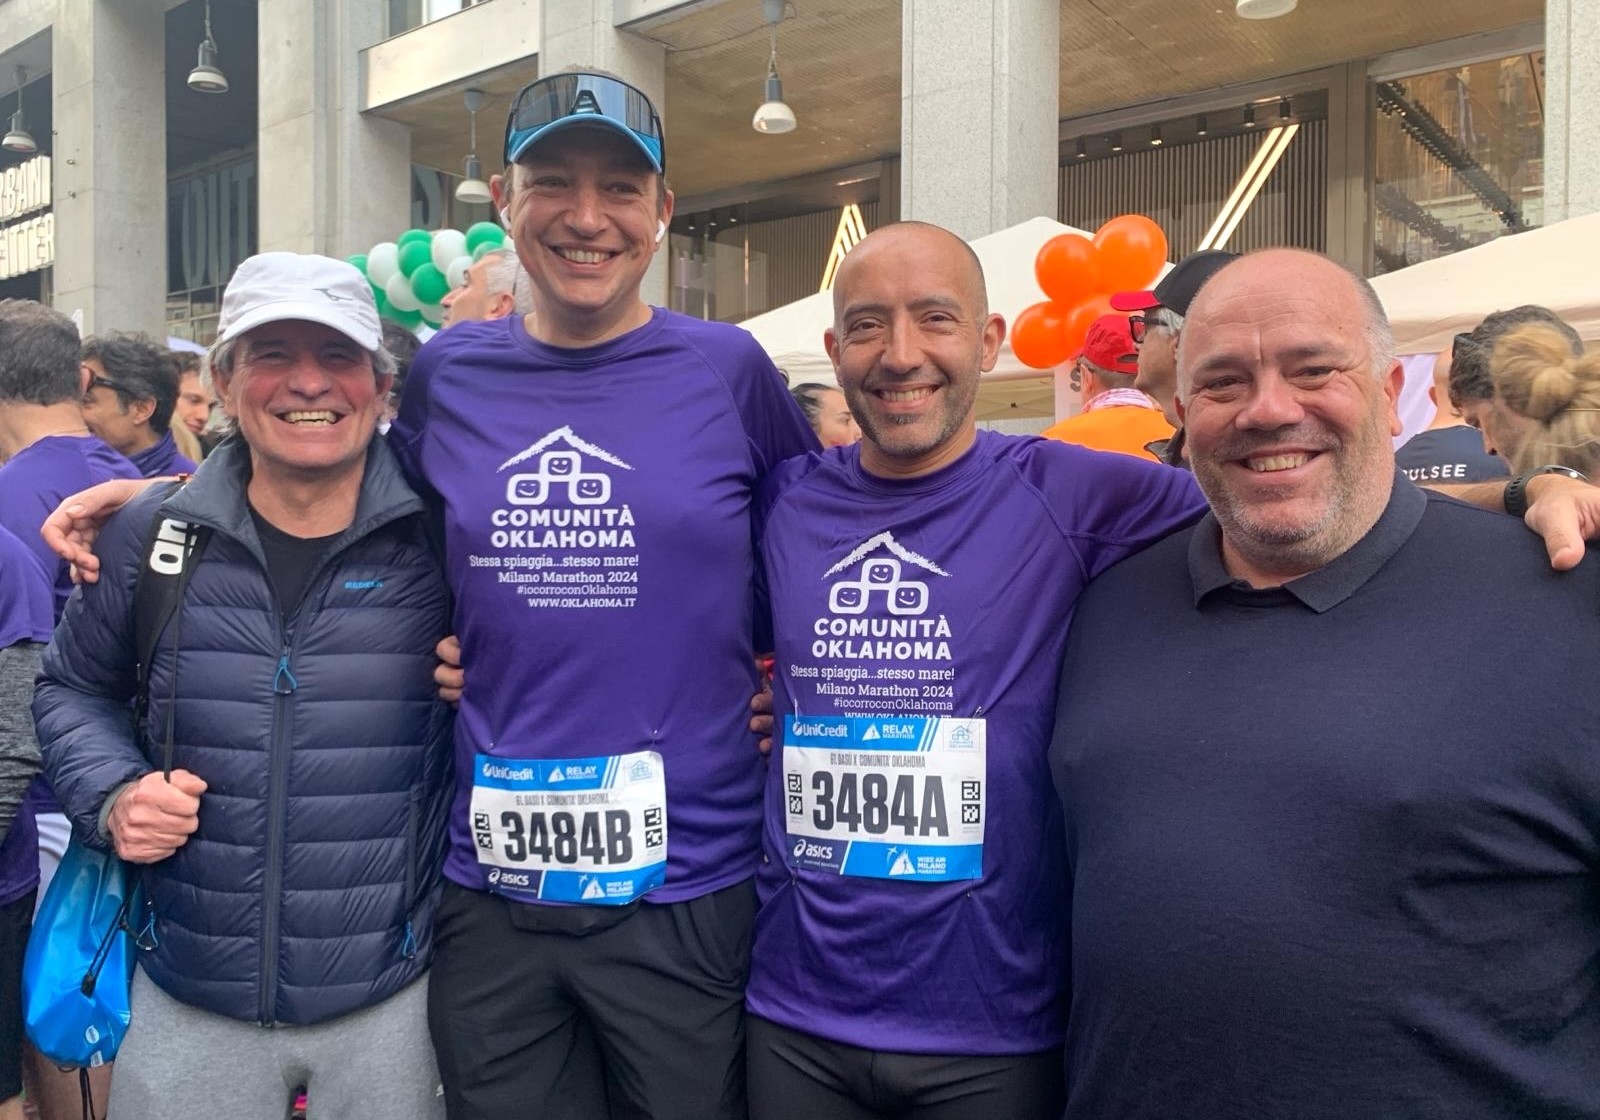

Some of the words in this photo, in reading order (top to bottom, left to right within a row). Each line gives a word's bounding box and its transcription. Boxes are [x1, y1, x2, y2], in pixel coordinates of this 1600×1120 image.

[1402, 463, 1468, 481] ULSEE
[491, 504, 635, 527] COMUNITÀ
[490, 530, 636, 548] OKLAHOMA
[469, 554, 502, 567] Stessa
[603, 554, 639, 567] mare!
[498, 571, 540, 583] Milano
[542, 571, 605, 583] Marathon
[607, 571, 638, 584] 2024
[517, 584, 638, 595] #iocorroconOklahoma
[528, 598, 636, 608] WWW.OKLAHOMA.IT
[813, 614, 952, 638] COMUNITÀ
[811, 640, 952, 660] OKLAHOMA
[790, 664, 819, 678] Stessa
[918, 667, 955, 681] mare!
[816, 683, 856, 696] Milano
[858, 683, 919, 698] Marathon
[922, 685, 954, 698] 2024
[834, 697, 953, 711] #iocorroconOklahoma
[802, 723, 848, 738] UniCredit
[882, 724, 915, 734] RELAY
[492, 766, 534, 780] UniCredit
[566, 765, 597, 776] RELAY
[812, 771, 949, 837] 3484A
[501, 809, 633, 865] 3484B
